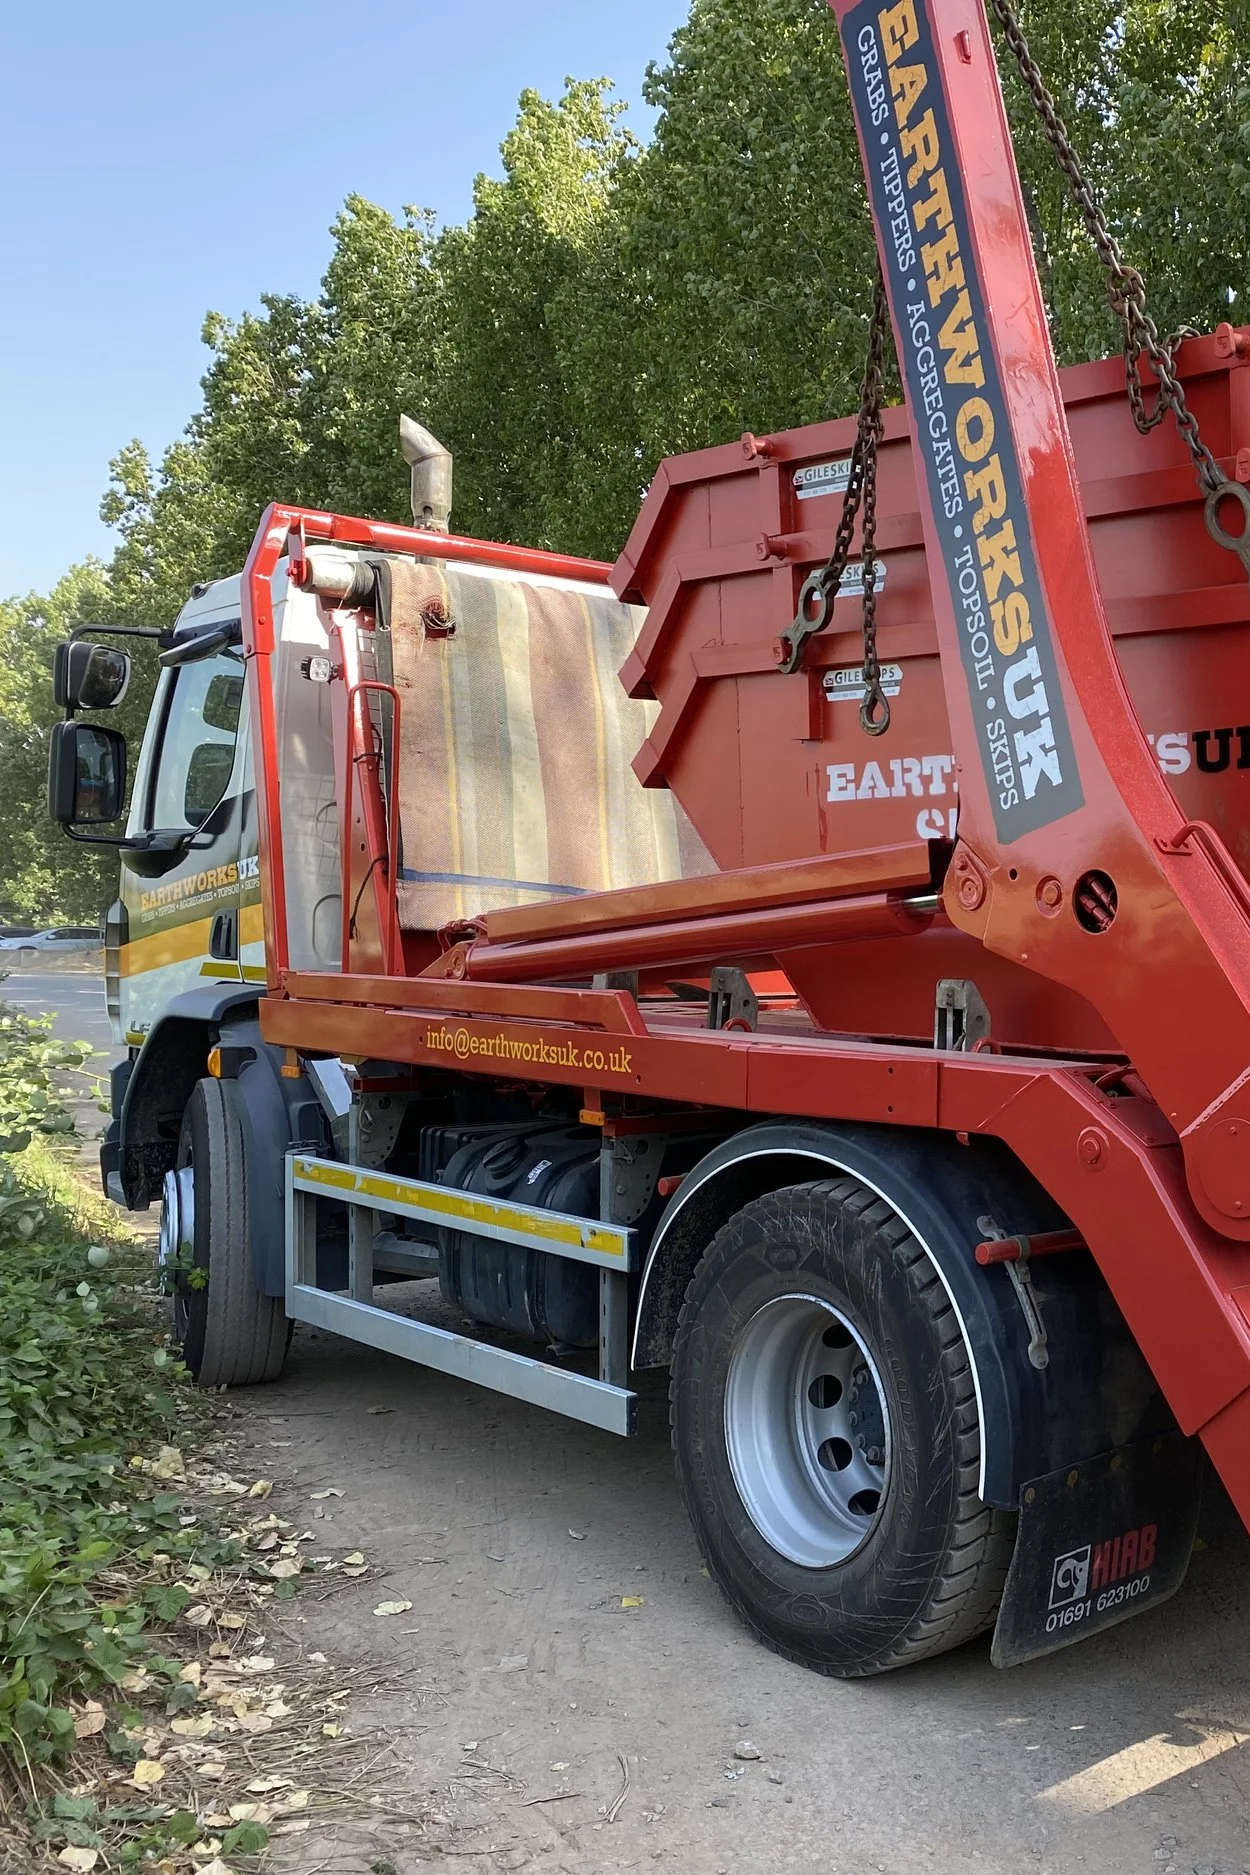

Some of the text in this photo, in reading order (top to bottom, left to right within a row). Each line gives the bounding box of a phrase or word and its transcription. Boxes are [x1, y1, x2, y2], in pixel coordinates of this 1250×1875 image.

[857, 24, 1019, 810] GRABS TIPPERS AGGREGATES TOPSOIL SKIPS
[877, 3, 1063, 801] EARTHWORKSUK
[804, 462, 849, 482] GILESKI
[141, 855, 259, 911] EARTHWORKSUK
[426, 1025, 632, 1073] info@earthworksuk.co.uk
[1090, 1523, 1158, 1592] HIAB
[1045, 1575, 1150, 1633] 01691 623100
